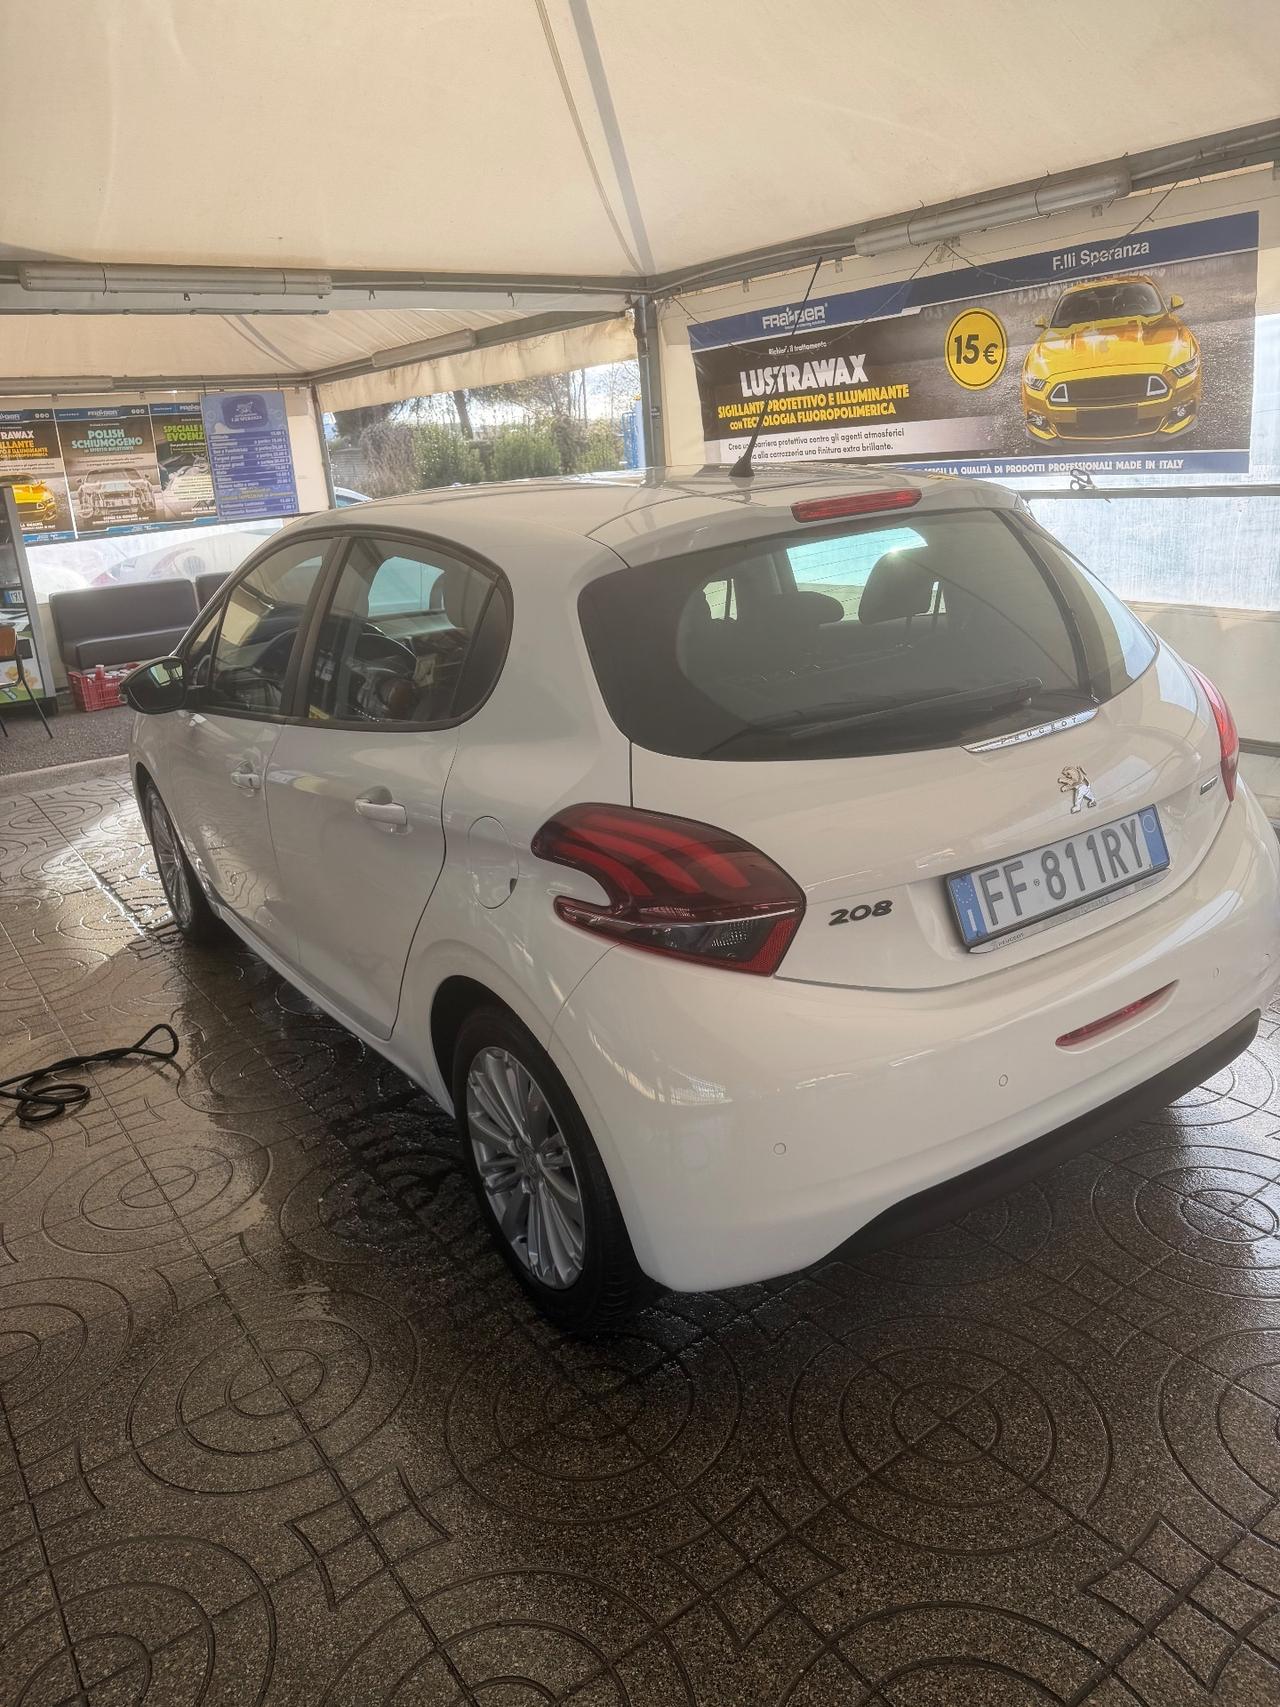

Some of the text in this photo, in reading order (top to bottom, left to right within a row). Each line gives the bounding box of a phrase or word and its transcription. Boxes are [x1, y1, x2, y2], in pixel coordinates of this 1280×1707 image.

[1052, 240, 1150, 271] F.lli Speranza
[794, 340, 828, 352] trattamento
[954, 333, 998, 365] 15 €
[740, 353, 869, 398] LUSTRAWAX
[767, 392, 829, 413] PROTETTIVO
[828, 392, 835, 406] E
[835, 383, 910, 405] ILLUMINANTE
[163, 423, 200, 433] SPECIALE
[742, 412, 797, 429] TECOLOGIA
[797, 402, 897, 424] FLUOROPOLIMERICA
[71, 436, 143, 449] SCHIUMOGENO
[87, 428, 125, 440] POLISH
[778, 437, 808, 448] protettiva
[809, 435, 830, 444] contro
[830, 432, 840, 444] gli
[840, 431, 863, 443] agenti
[864, 427, 905, 440] atmosferici
[757, 450, 769, 459] alla
[769, 448, 804, 458] carrozzeria
[804, 448, 817, 456] una
[817, 445, 842, 455] finitura
[842, 444, 861, 453] extra
[861, 442, 894, 452] brillante.
[948, 466, 959, 475] LA
[960, 463, 992, 474] QUALITÀ
[994, 464, 1004, 474] DI
[1006, 462, 1046, 473] PRODOTTI
[1048, 460, 1113, 472] PROFESSIONALI
[1115, 459, 1143, 470] MADE
[1145, 459, 1156, 470] IN
[1159, 459, 1185, 469] ITALY
[1000, 716, 1078, 745] PEUGEOT
[978, 817, 1143, 927] FF 811RY
[828, 899, 893, 927] 208
